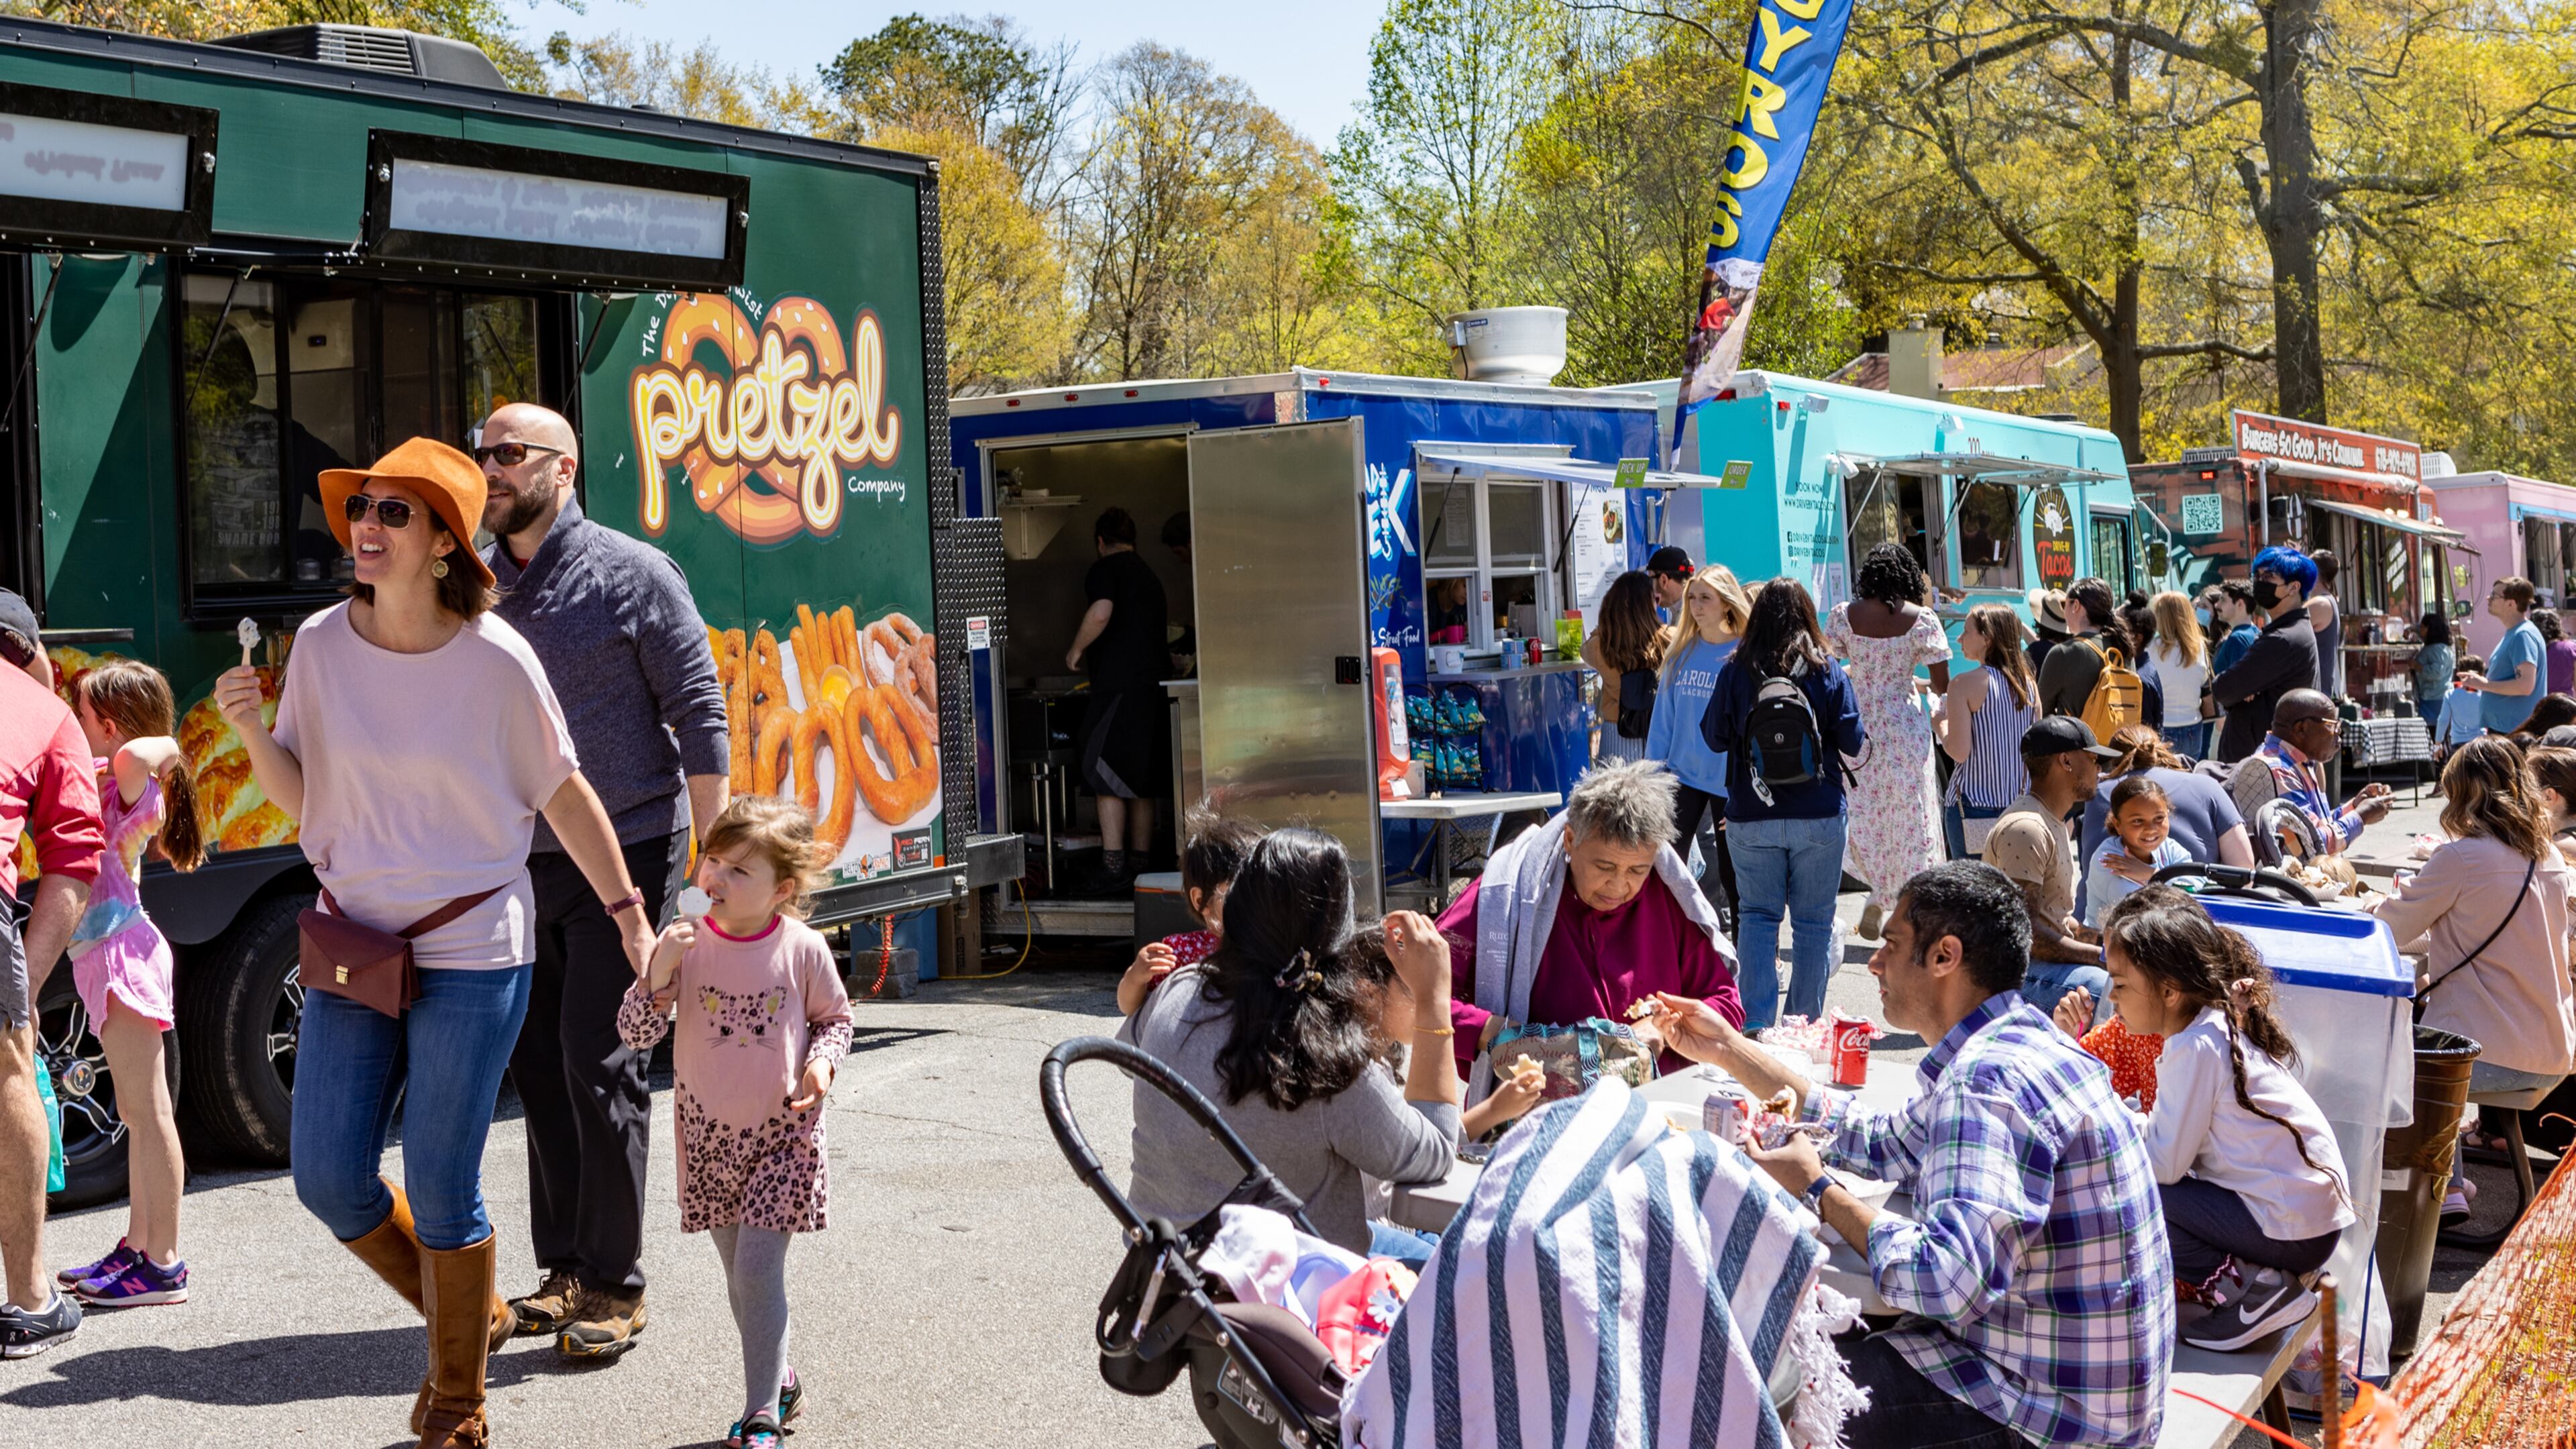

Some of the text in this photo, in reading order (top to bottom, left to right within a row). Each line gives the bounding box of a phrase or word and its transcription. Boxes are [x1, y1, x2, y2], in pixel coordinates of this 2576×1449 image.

[642, 285, 762, 357] The wist
[634, 314, 900, 532] pretzel
[1620, 462, 1646, 474] PICK UP
[1729, 465, 1748, 476] ORDER
[848, 476, 905, 503] Company
[2037, 540, 2074, 582] Tacos
[1379, 627, 1401, 648] Street
[1402, 625, 1419, 647] Food
